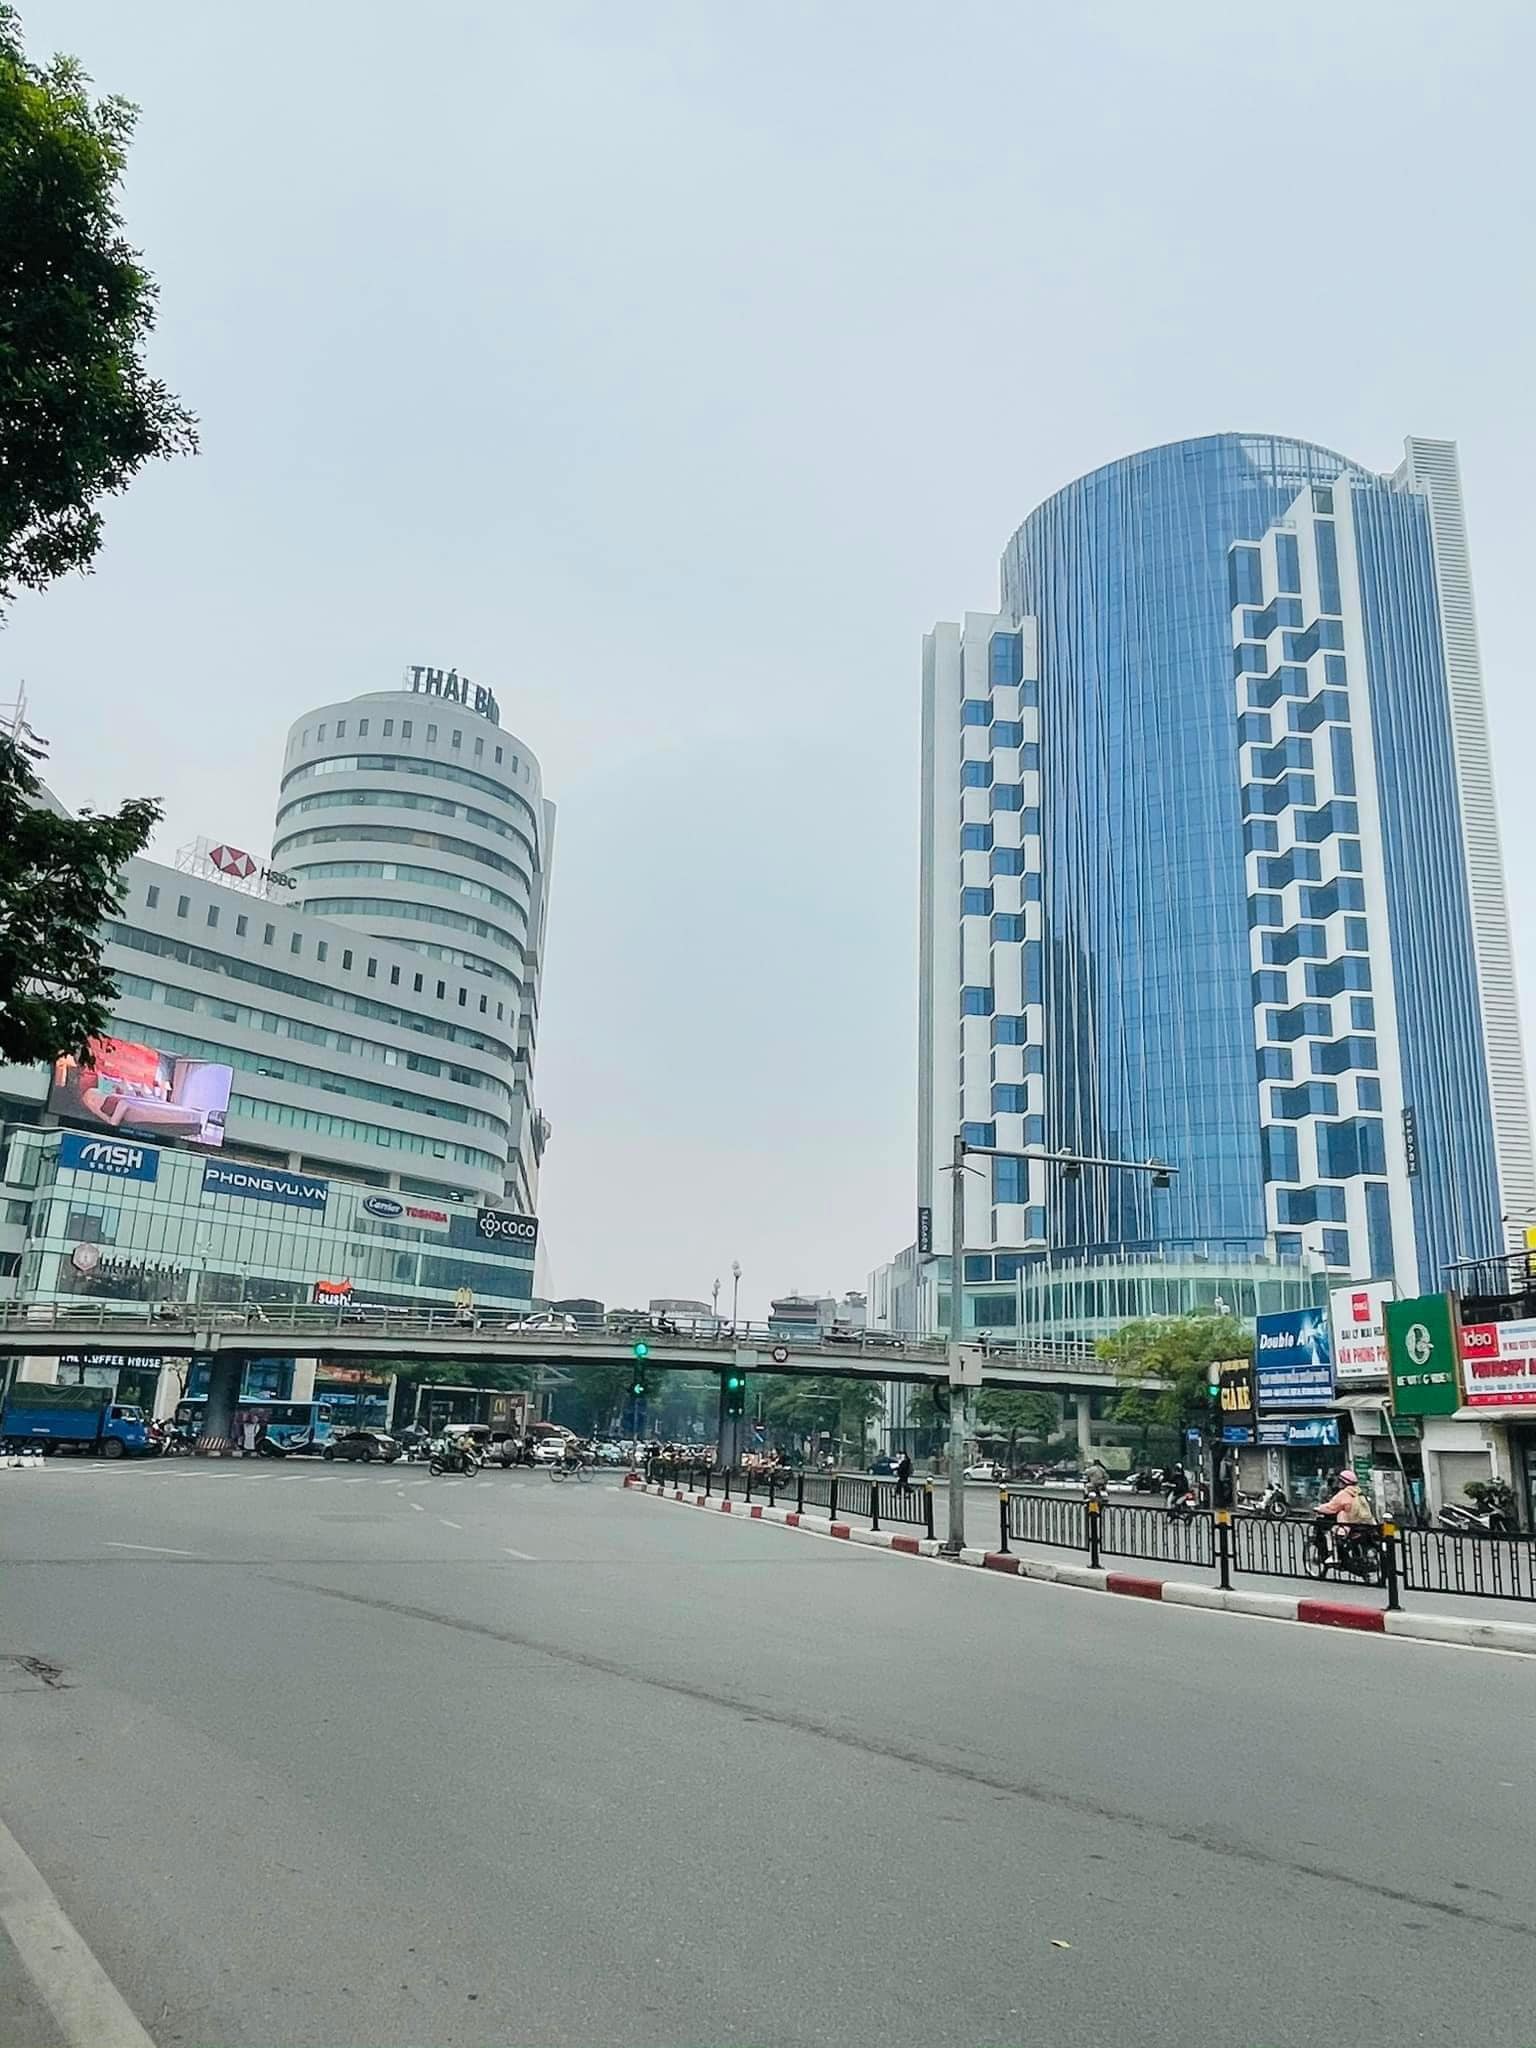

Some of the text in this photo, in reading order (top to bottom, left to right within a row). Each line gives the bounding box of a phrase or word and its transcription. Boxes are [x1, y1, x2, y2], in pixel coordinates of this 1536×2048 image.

[411, 665, 469, 704] THÁI
[260, 866, 297, 890] HSBC
[206, 1168, 327, 1201] PHONGVU.VN
[501, 1220, 535, 1238] COCO
[1259, 1331, 1295, 1350] Double
[127, 1357, 161, 1368] HOUSE
